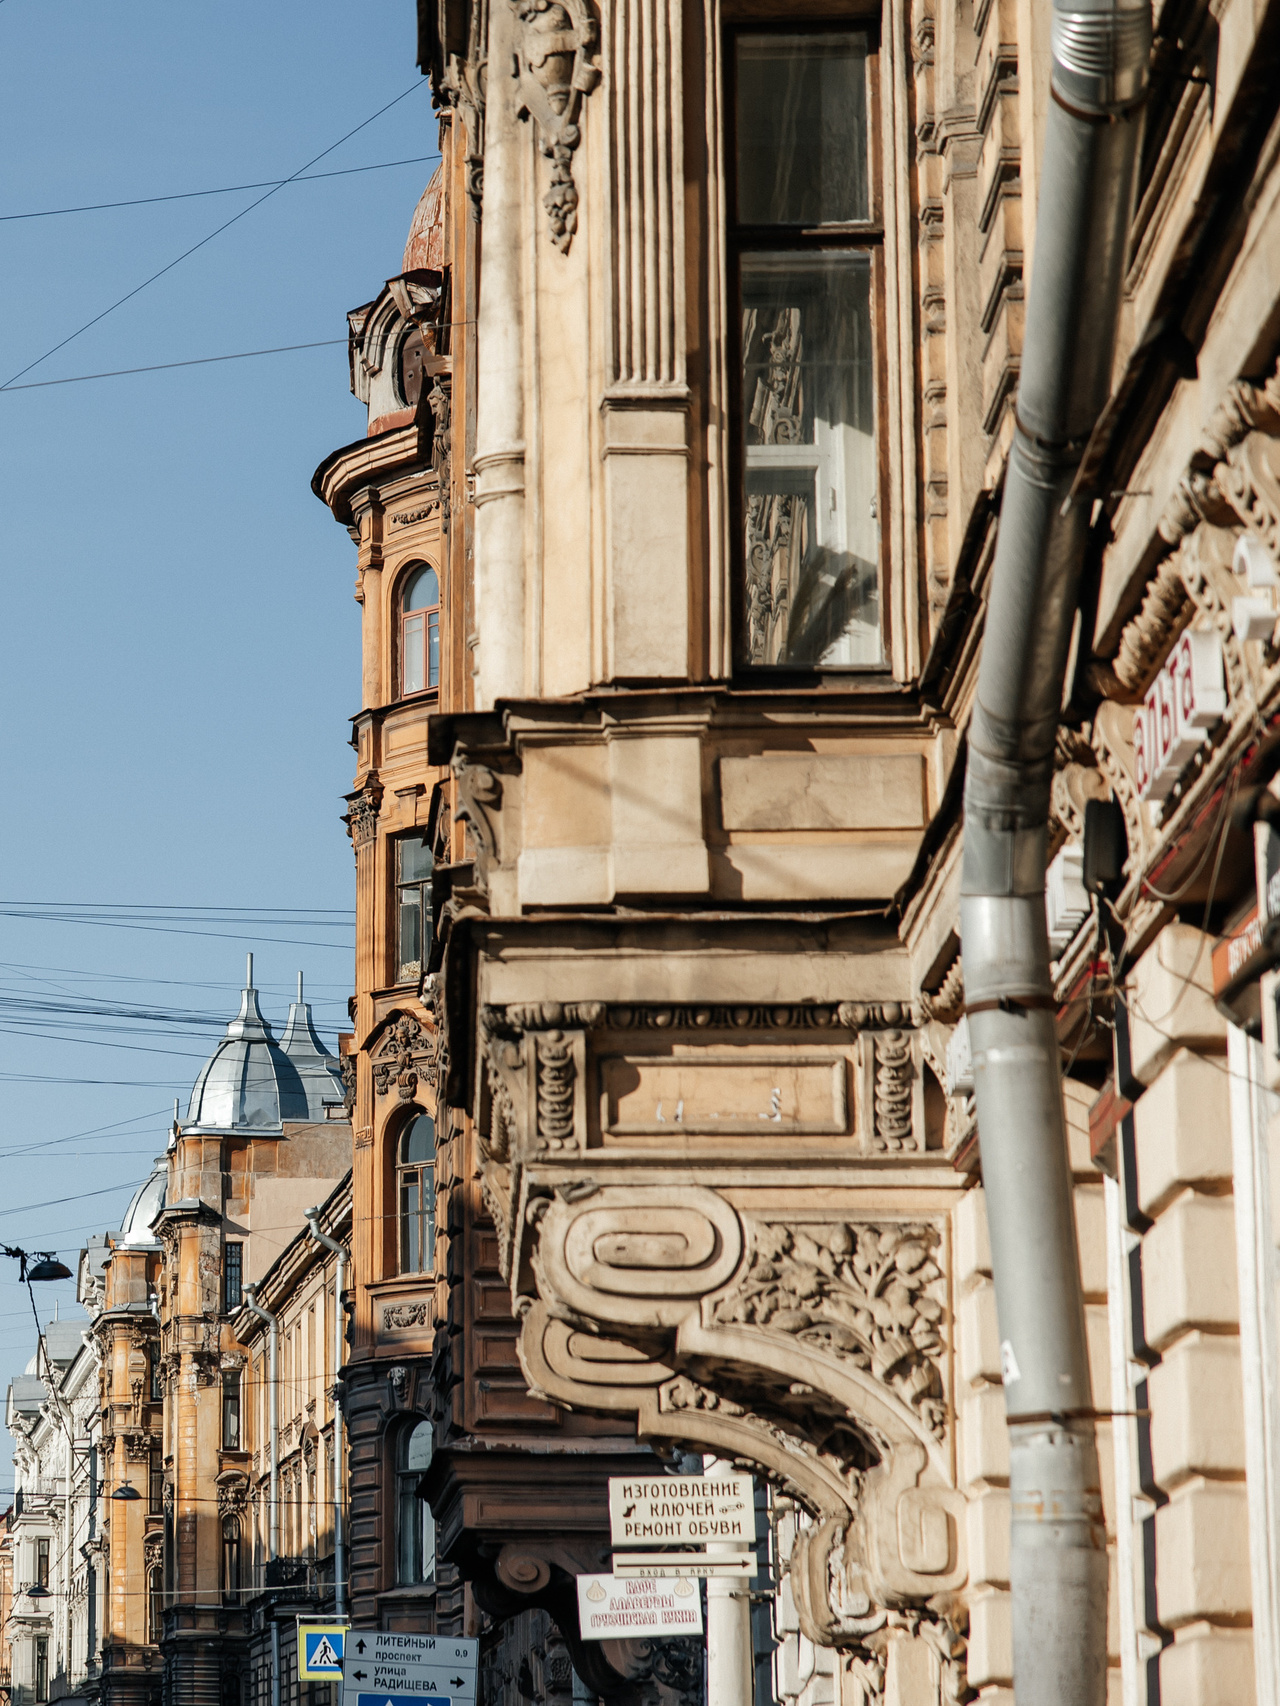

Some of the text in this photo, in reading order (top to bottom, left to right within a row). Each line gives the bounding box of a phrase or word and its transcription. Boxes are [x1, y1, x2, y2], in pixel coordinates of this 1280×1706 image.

[623, 1482, 740, 1499] ИЗГОТОВЛЕНИЕ
[650, 1499, 715, 1517] КЛЮЧЕЙ
[625, 1520, 741, 1537] РЕМОНТ ОБУВИ
[640, 1567, 715, 1578] ВХОД В АРКУ
[626, 1579, 657, 1595] КАФЕ
[609, 1594, 674, 1611] АЛАВЕРДЫ
[590, 1609, 697, 1628] ГРУЗИНСКАЯ КУХНЯ
[376, 1635, 436, 1650] ЛИТЕЙНЫЙ
[375, 1651, 422, 1662] проспект
[455, 1648, 468, 1658] 0,9
[374, 1666, 407, 1677] улица
[374, 1677, 437, 1692] РАДИЩЕВА
